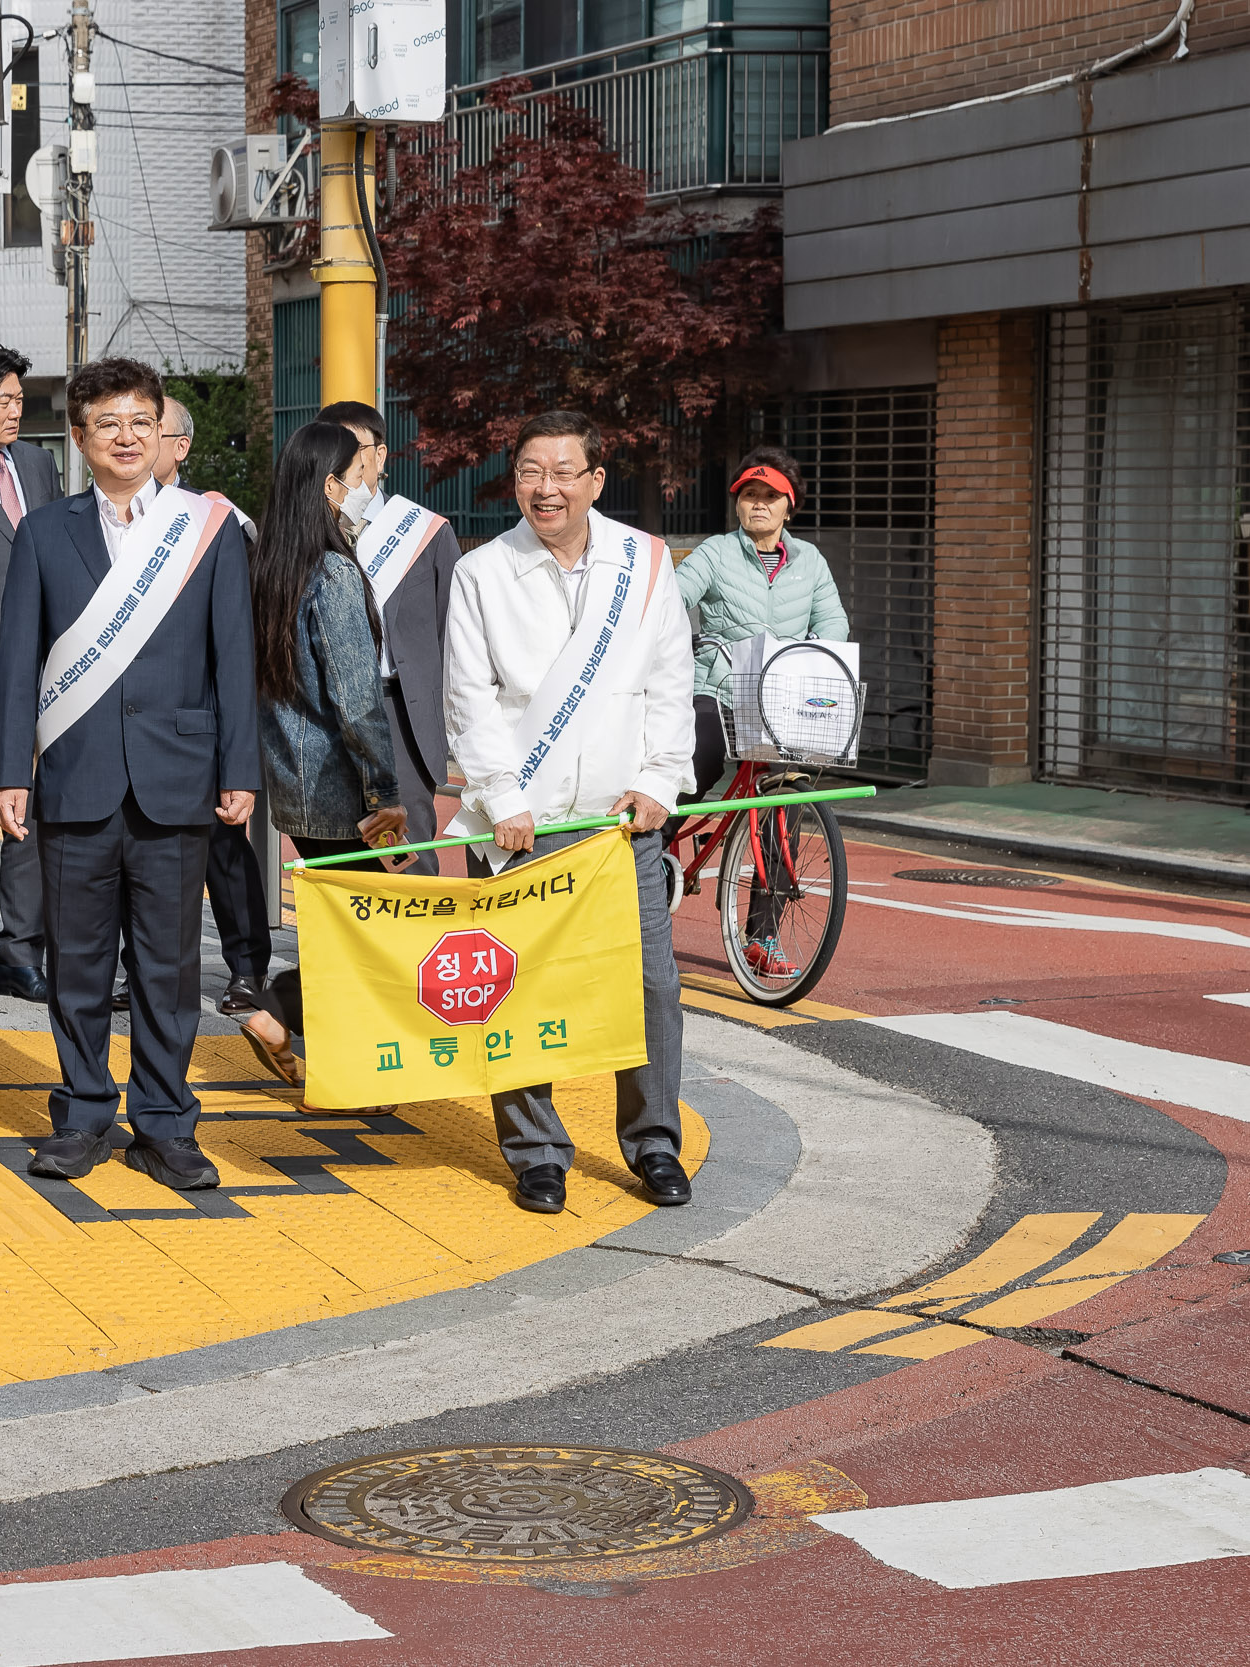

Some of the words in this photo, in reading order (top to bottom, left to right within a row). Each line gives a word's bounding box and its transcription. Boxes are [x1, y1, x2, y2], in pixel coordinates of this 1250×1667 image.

[162, 511, 191, 548] 소중한
[395, 505, 423, 537] 소중한
[132, 545, 172, 597] 아이들의
[363, 534, 401, 579] 아이들의
[95, 593, 141, 650] 등하굣길
[605, 571, 632, 628] 아이들의
[54, 646, 102, 695] 안전하게
[579, 624, 614, 687] 등하굣길
[542, 683, 587, 743] 안전하게
[349, 894, 459, 921] 정지선을
[469, 871, 577, 912] 지킵시다
[440, 982, 496, 1011] STOP
